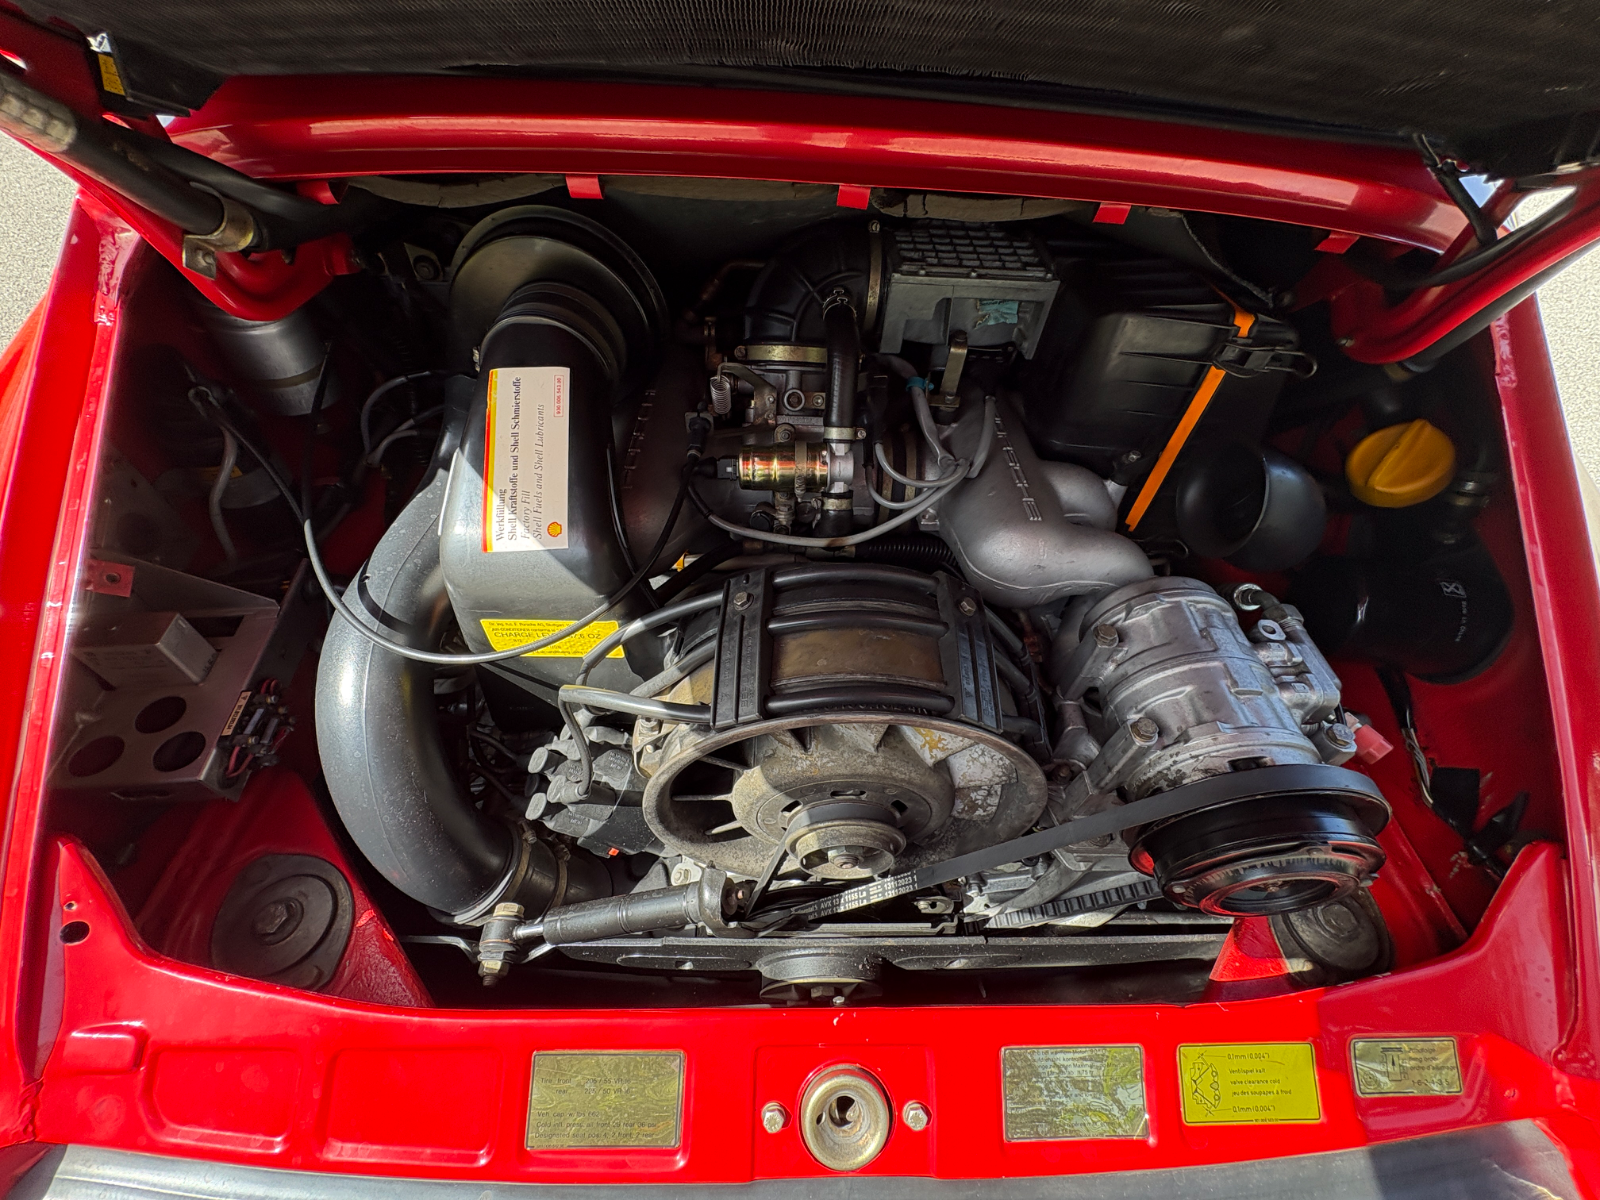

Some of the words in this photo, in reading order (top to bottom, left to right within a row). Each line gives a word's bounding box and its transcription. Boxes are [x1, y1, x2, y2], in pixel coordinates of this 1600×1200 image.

[511, 376, 521, 430] Schmierstoffe
[535, 404, 545, 447] Lubricants
[510, 432, 519, 453] Shell
[510, 455, 519, 471] und
[534, 449, 543, 471] Shell
[534, 472, 543, 490] and
[508, 472, 518, 515] Kraftstoffe
[521, 490, 530, 504] Fill
[533, 491, 542, 514] Fuels
[496, 488, 507, 542] Werkfüllung
[521, 506, 532, 539] Factory
[508, 517, 517, 541] Shell
[533, 516, 542, 539] Shell
[820, 909, 832, 917] AVX
[845, 901, 858, 910] 1155
[832, 898, 839, 906] 13
[845, 892, 858, 902] 1155
